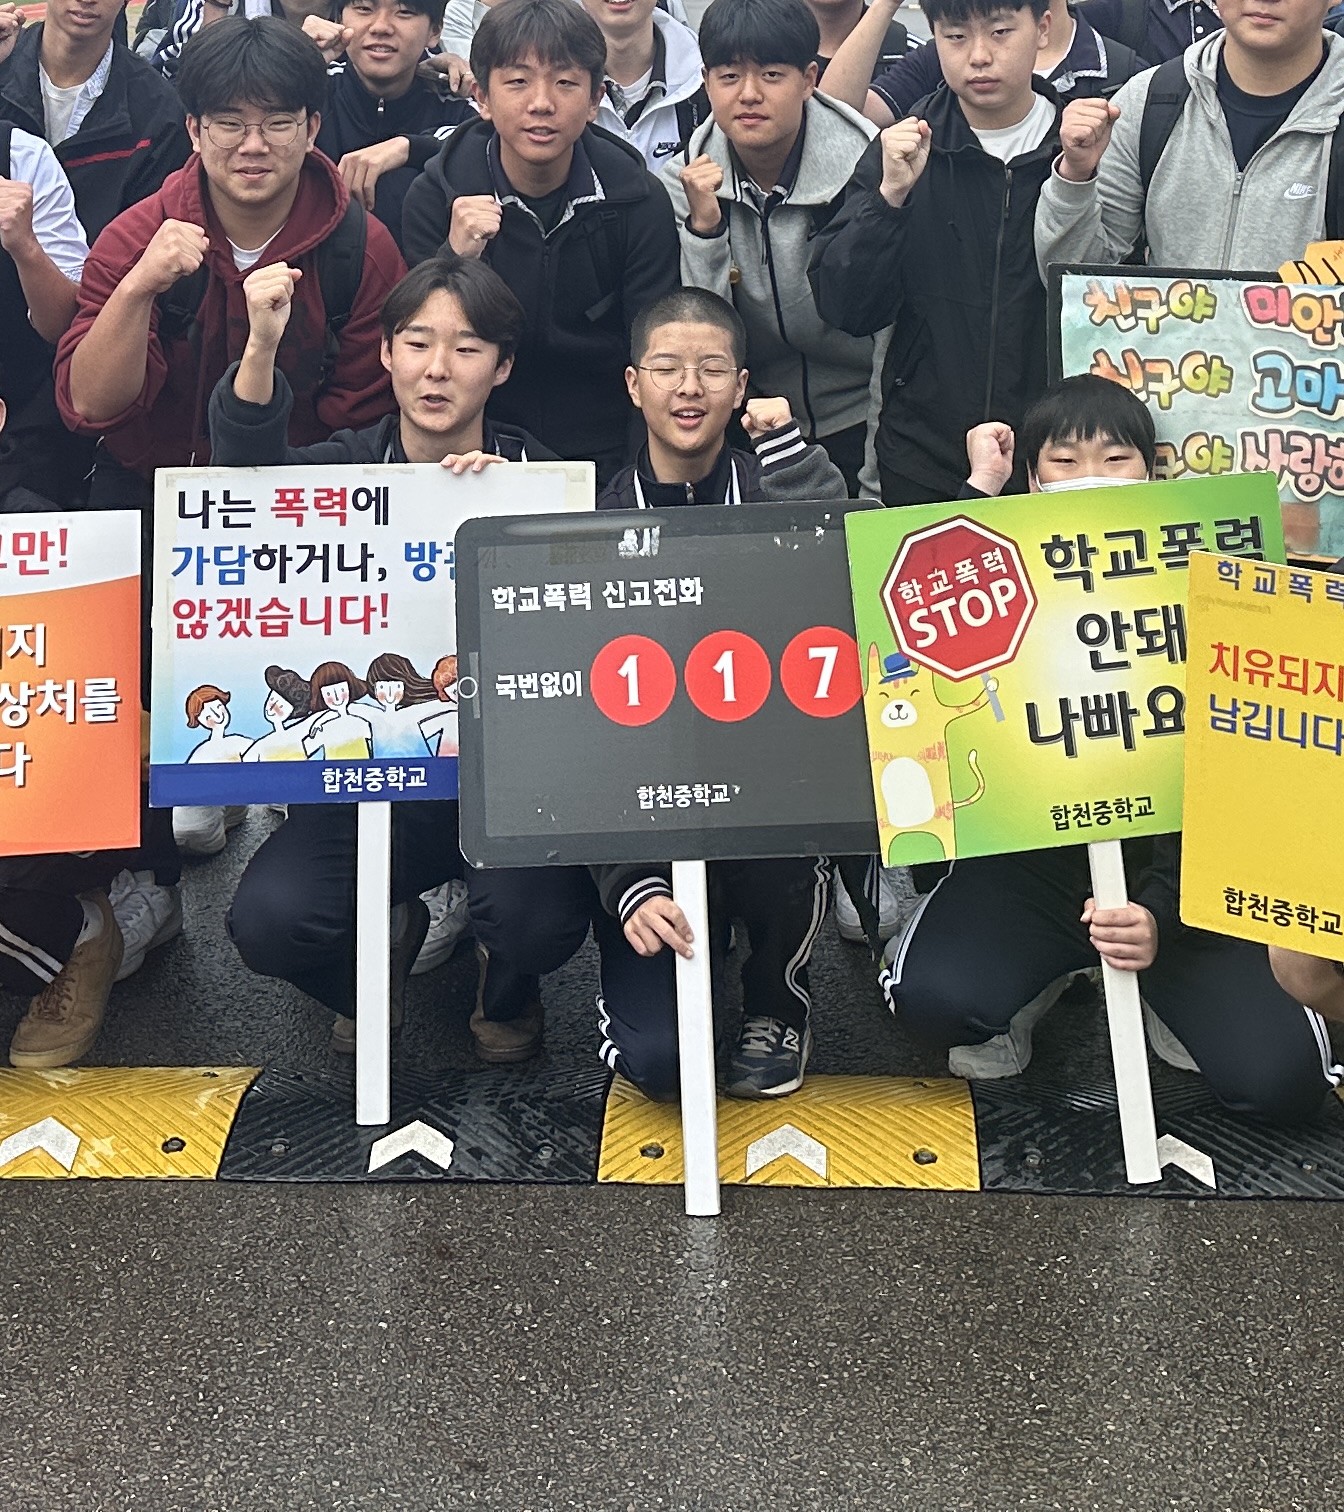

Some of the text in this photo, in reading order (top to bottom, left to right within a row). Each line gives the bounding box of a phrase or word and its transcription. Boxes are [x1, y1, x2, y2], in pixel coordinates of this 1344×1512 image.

[1083, 279, 1217, 334] 친구야
[178, 486, 390, 529] 나는 폭력에
[171, 543, 388, 586] 가담하거나,
[897, 546, 1009, 606] 학교폭력
[1040, 516, 1266, 594] 학교폭력
[173, 593, 390, 640] 않겠습니다!
[491, 576, 704, 614] 학교폭력 신고전화
[908, 577, 1018, 649] STOP
[495, 670, 583, 700] 국번없이
[322, 767, 428, 794] 합천중학교
[636, 783, 731, 810] 합천중학교
[1050, 796, 1156, 831] 합천중학교
[1223, 886, 1344, 936] 합천중학교
